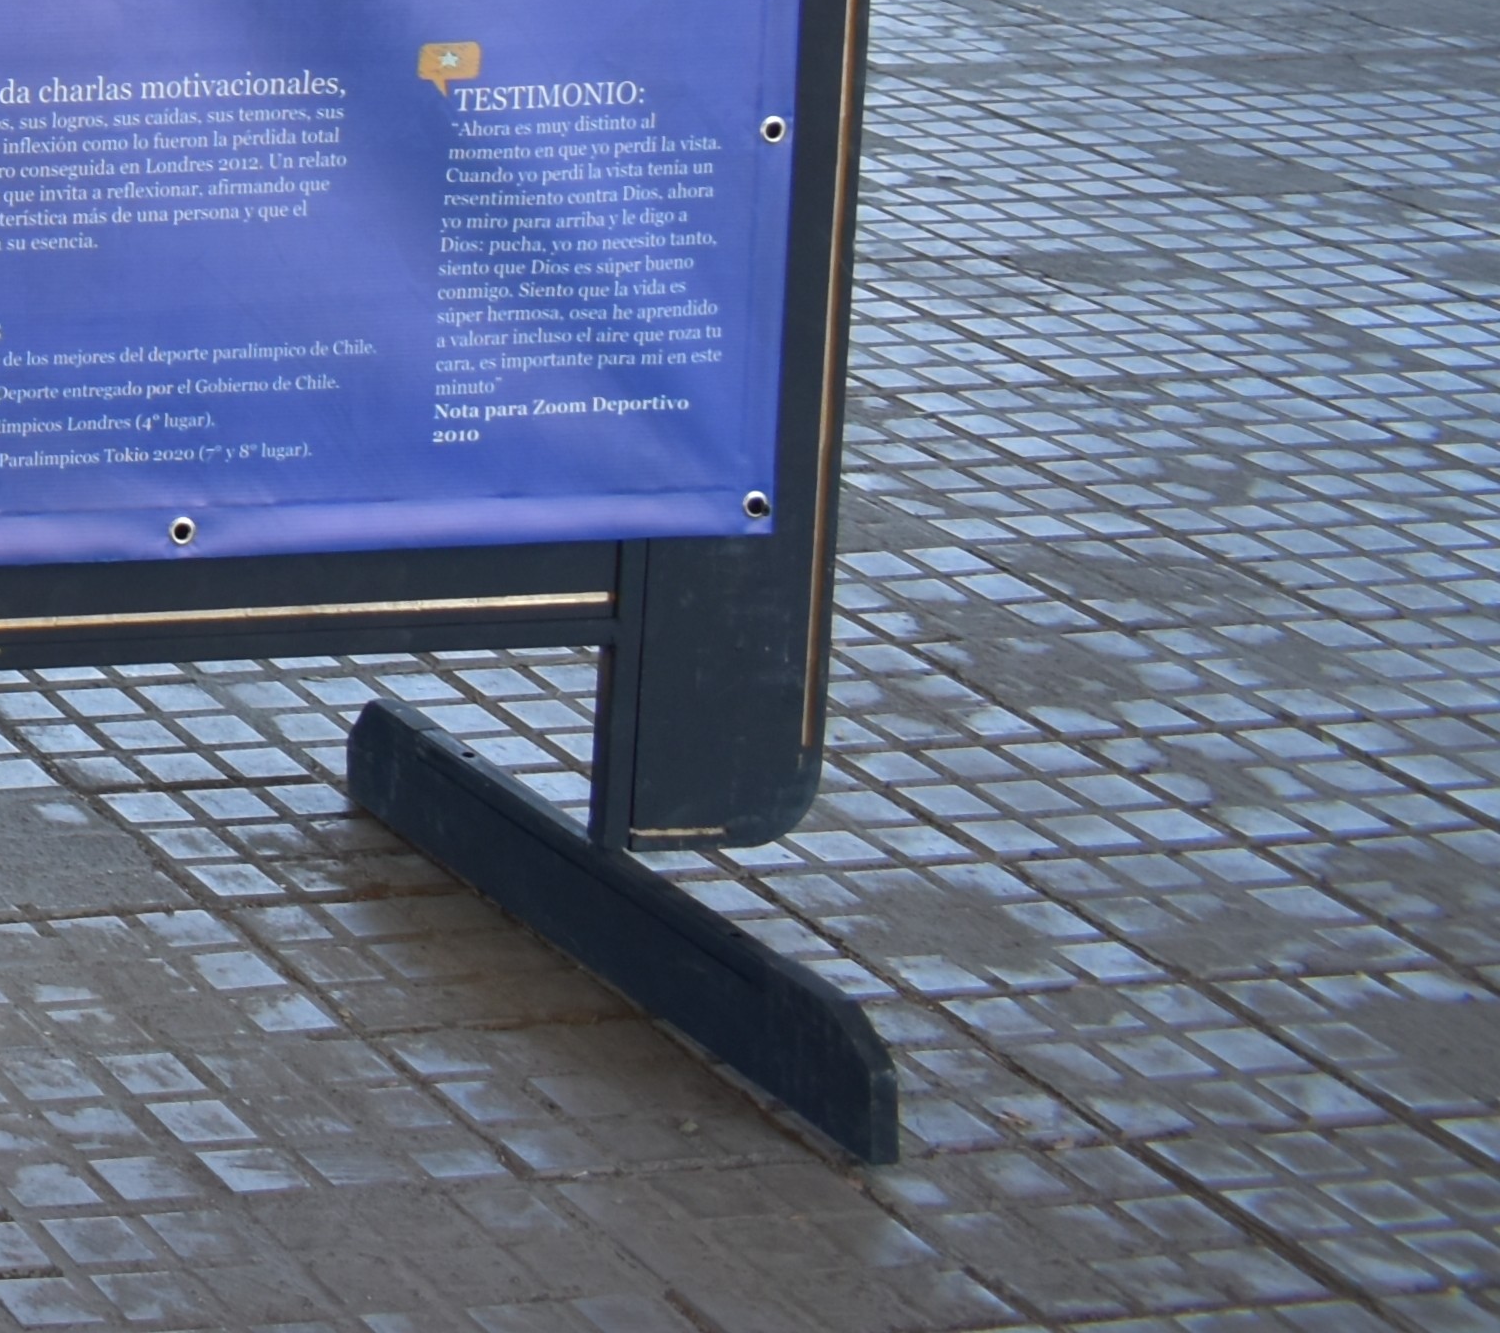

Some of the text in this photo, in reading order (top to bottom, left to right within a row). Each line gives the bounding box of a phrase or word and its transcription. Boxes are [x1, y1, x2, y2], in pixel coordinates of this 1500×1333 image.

[454, 80, 645, 112] TESTIMONIO:
[2, 350, 23, 367] de
[26, 350, 49, 366] los
[53, 349, 116, 366] mejores
[119, 346, 144, 363] del
[147, 345, 209, 366] deporte
[212, 342, 307, 364] paralímpico
[309, 340, 329, 356] de
[332, 338, 378, 357] Chile.
[434, 394, 689, 422] Nota para Zoom Deportivo
[432, 430, 480, 443] 2010
